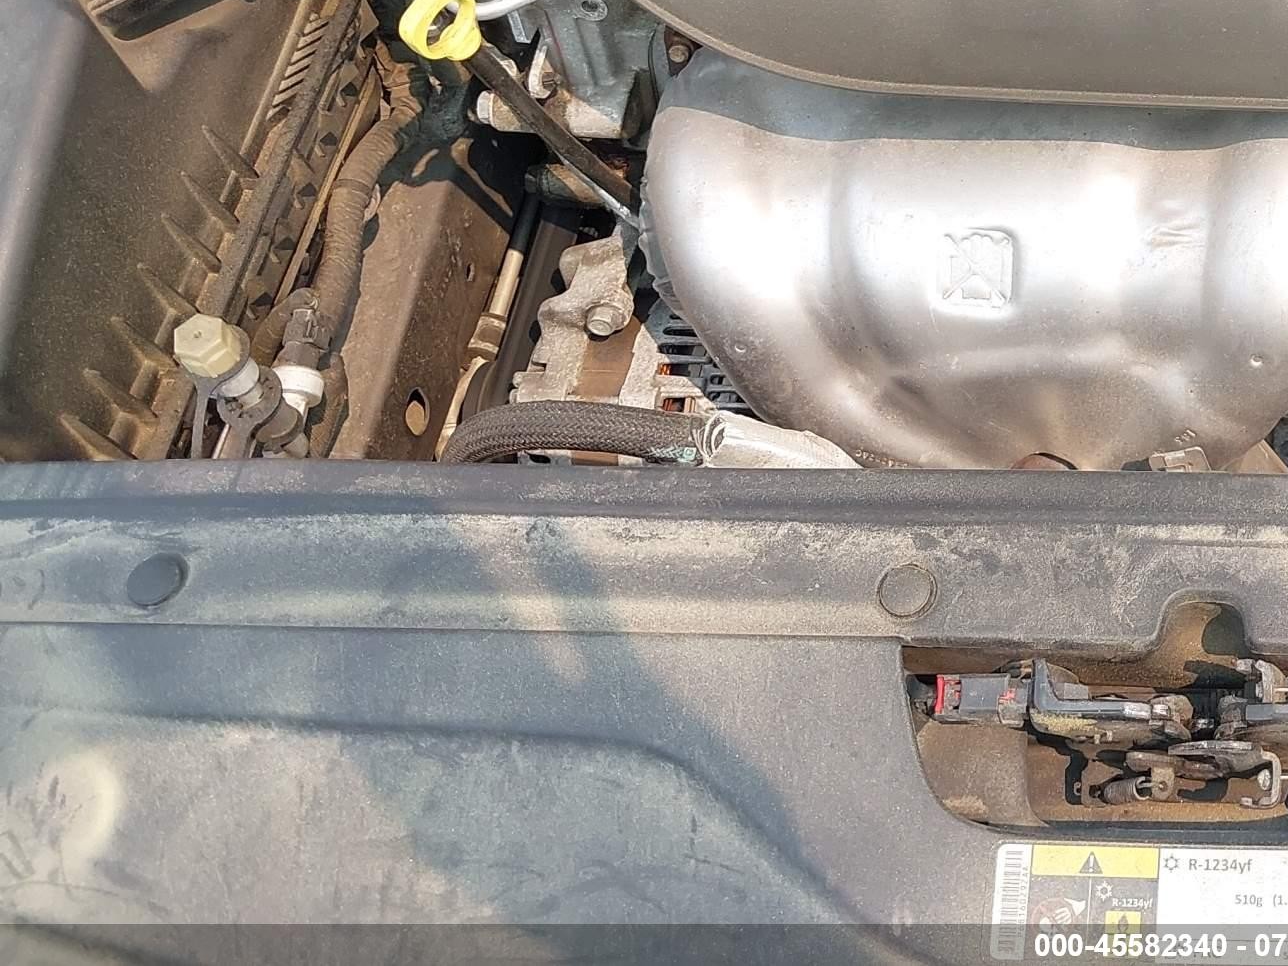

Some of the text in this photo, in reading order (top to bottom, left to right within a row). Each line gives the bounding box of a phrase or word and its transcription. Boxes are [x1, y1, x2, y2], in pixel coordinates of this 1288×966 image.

[1188, 858, 1254, 874] R-1234yf
[1112, 898, 1154, 909] R-1234yf
[1234, 894, 1263, 907] 510g
